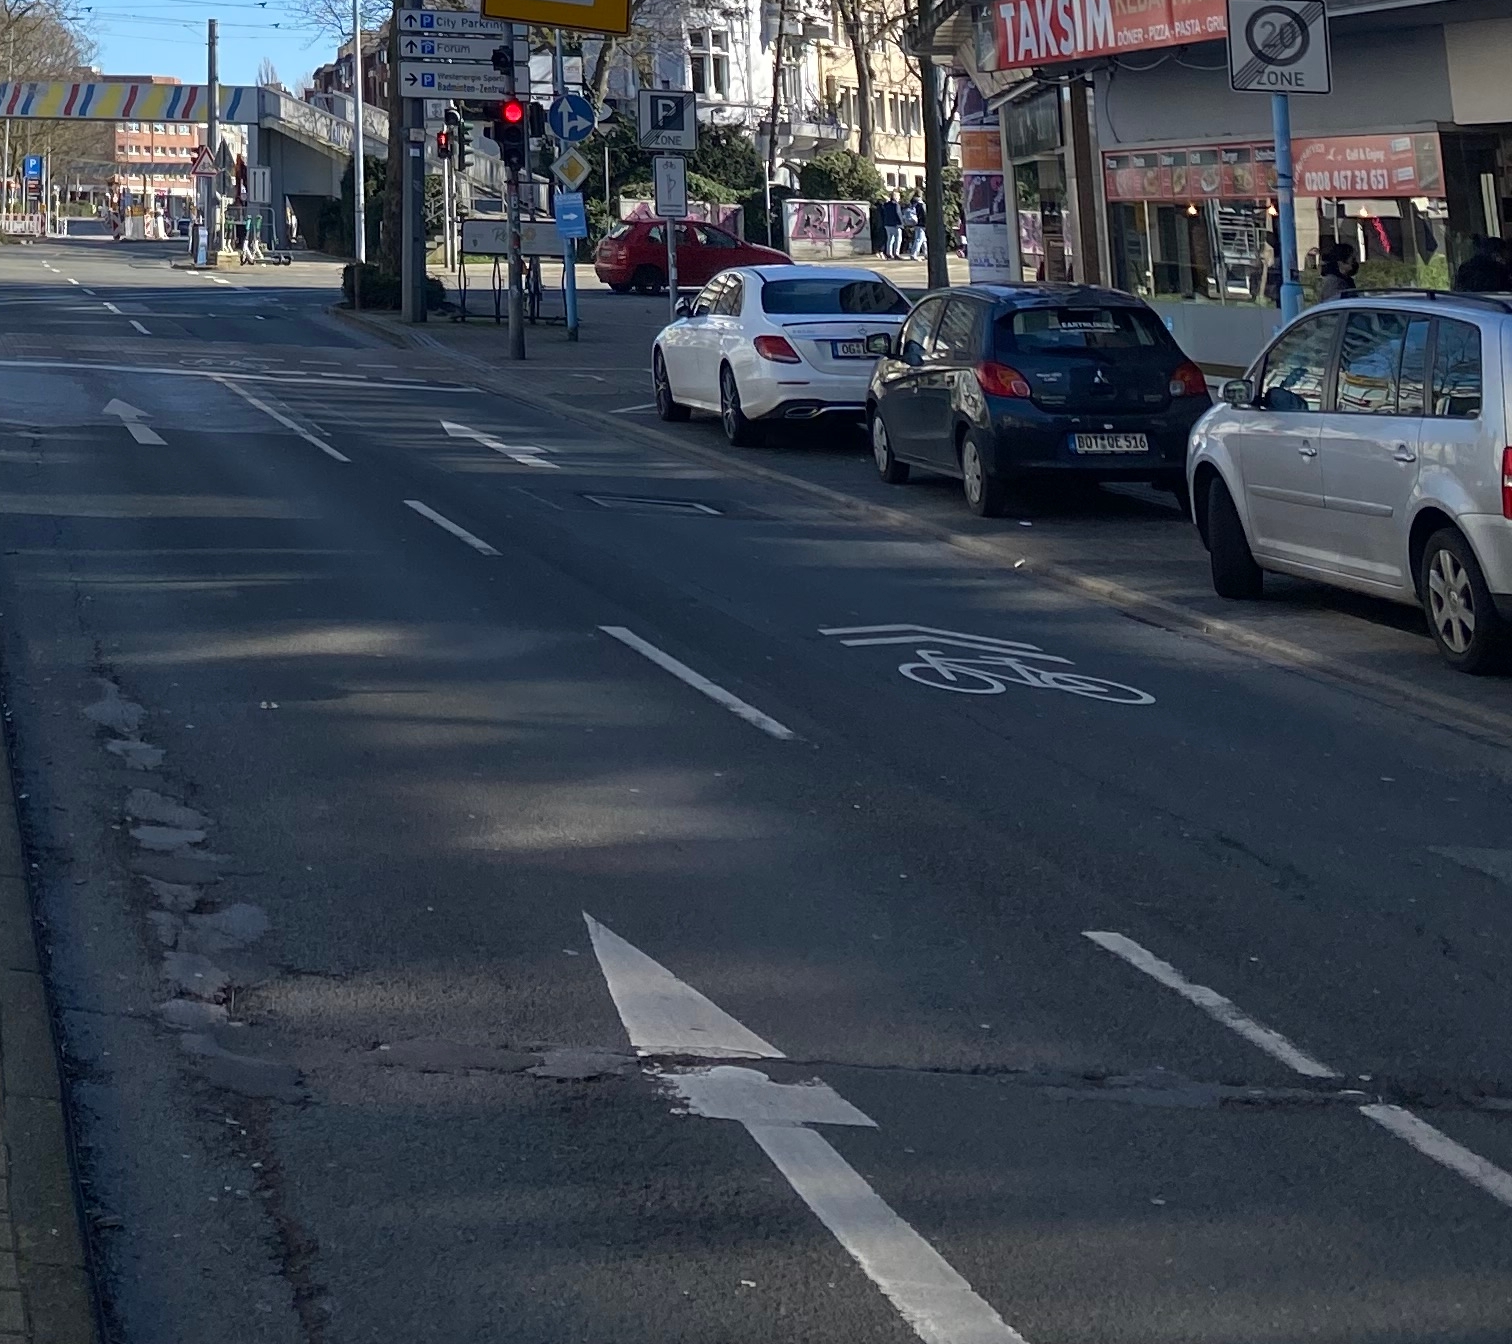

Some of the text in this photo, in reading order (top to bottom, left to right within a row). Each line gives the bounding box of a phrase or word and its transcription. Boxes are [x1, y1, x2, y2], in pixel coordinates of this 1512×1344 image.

[436, 17, 457, 30] City
[1117, 15, 1227, 47] DÖNER PIZZA PASTA GRIL
[437, 42, 471, 53] Forum
[1256, 70, 1305, 87] ZONE
[654, 135, 683, 146] ZONE
[1304, 171, 1332, 192] 0208
[1332, 169, 1353, 191] 467
[1355, 169, 1369, 191] 32
[1370, 168, 1389, 190] 651
[1124, 435, 1146, 449] 516
